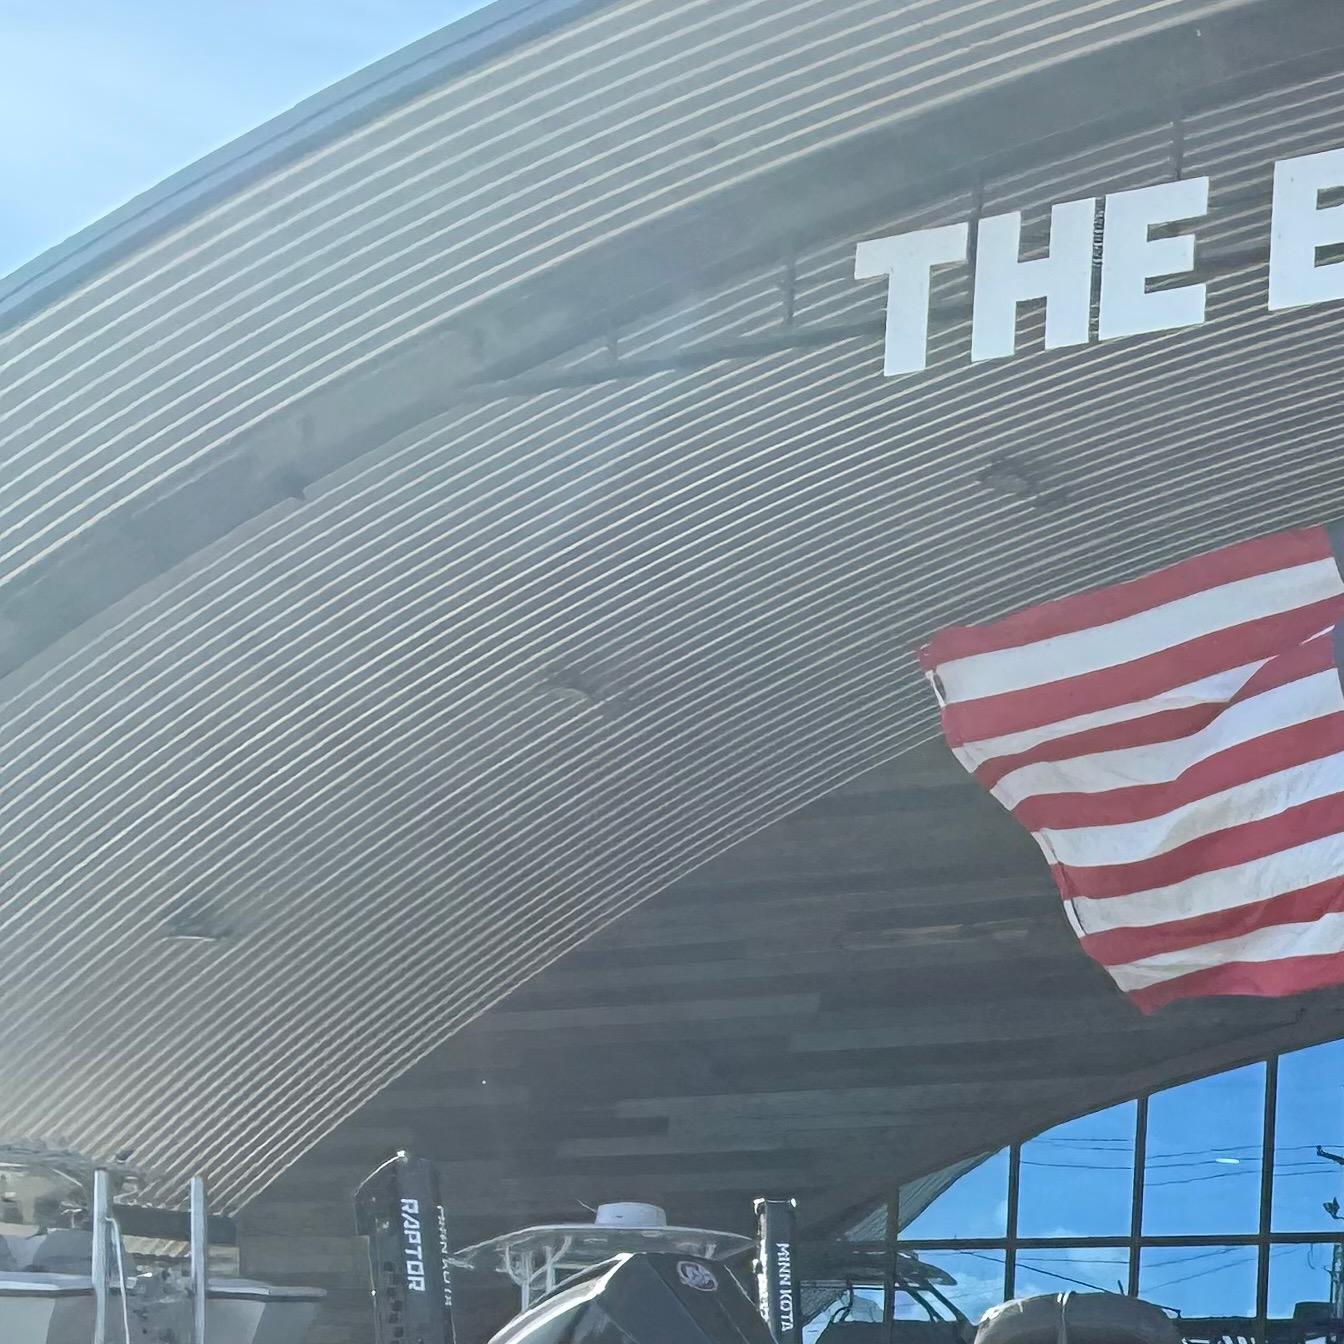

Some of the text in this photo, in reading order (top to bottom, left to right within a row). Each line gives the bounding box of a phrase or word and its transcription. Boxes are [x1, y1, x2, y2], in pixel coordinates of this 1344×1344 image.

[854, 175, 1210, 377] THE
[400, 1198, 425, 1292] RAPTOR
[776, 1243, 794, 1332] MINN KOTA
